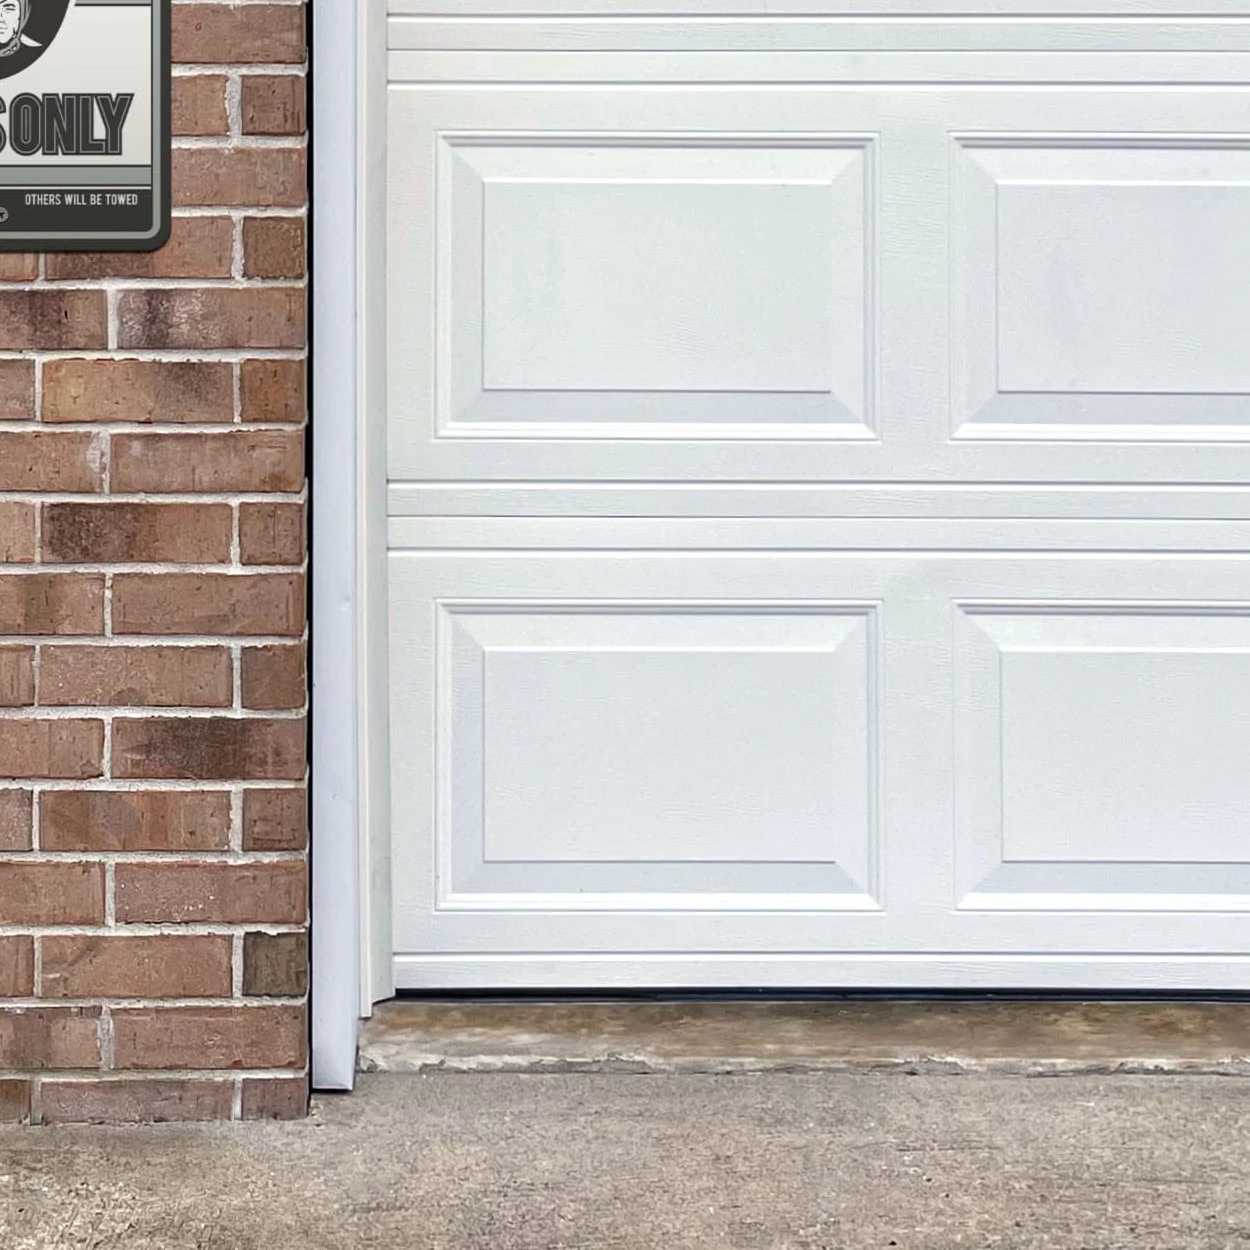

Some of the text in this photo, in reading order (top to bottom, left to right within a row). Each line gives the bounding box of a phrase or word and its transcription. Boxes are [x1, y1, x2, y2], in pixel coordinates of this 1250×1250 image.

[8, 92, 134, 156] ONLY
[24, 193, 138, 206] OTHERS WILL BE TOWED
